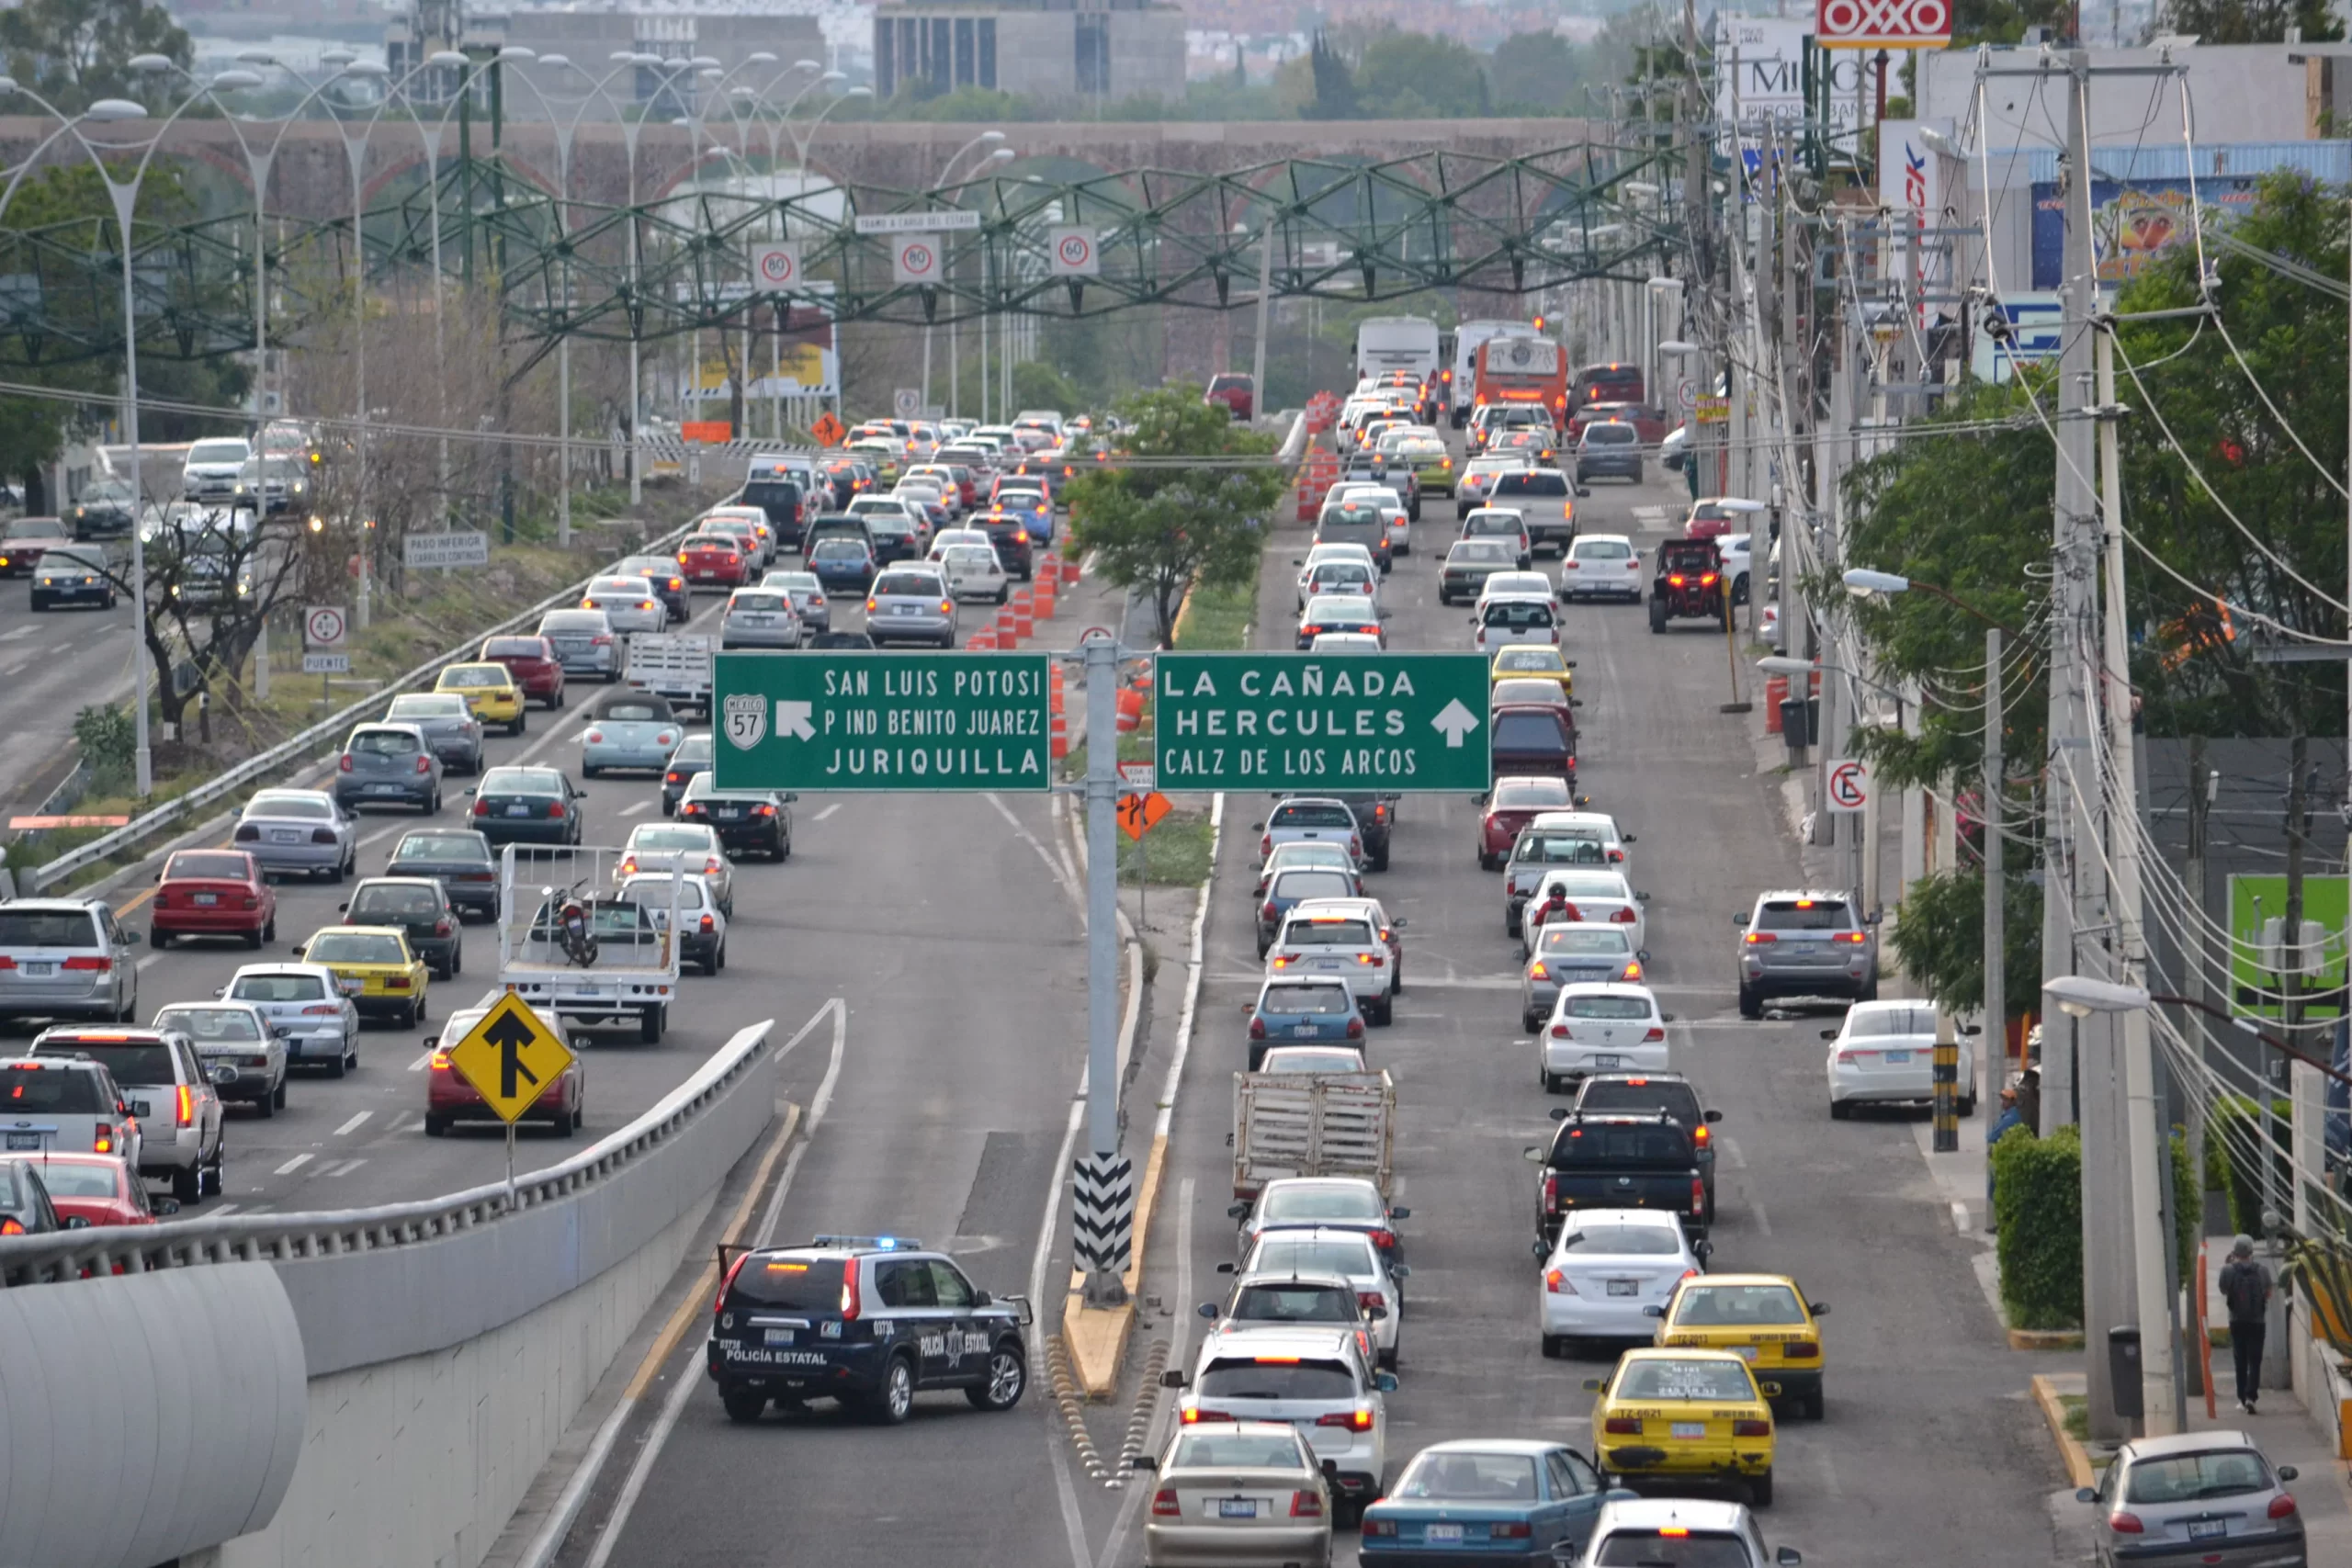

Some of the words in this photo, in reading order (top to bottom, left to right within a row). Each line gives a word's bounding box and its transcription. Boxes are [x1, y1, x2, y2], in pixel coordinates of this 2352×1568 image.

[1825, 0, 1946, 35] OXXO
[909, 250, 925, 265] 80
[1066, 243, 1081, 256] 60
[768, 258, 785, 272] 80
[411, 538, 436, 549] PASO
[437, 536, 481, 548] INFERIOR
[305, 658, 347, 669] PUENTE
[824, 670, 869, 696] SAN
[884, 670, 938, 696] LUIS
[954, 670, 1040, 696] POTOSI
[1164, 671, 1217, 696] LA
[1240, 664, 1416, 697] CAÑADA
[733, 714, 759, 737] 57
[824, 709, 835, 735] P
[846, 709, 877, 735] IND
[888, 709, 956, 735] BENITO
[966, 709, 1040, 736] JUAREZ
[1177, 709, 1407, 737] HERCULES
[825, 749, 1040, 775] JURIQUILLA
[1164, 748, 1226, 775] CALZ
[1241, 749, 1269, 774] DE
[1285, 748, 1328, 775] LOS
[1341, 748, 1417, 775] ARCOS
[965, 1333, 991, 1354] ESTATAL
[727, 1348, 773, 1362] POLICÍA
[775, 1351, 828, 1365] ESTATAL
